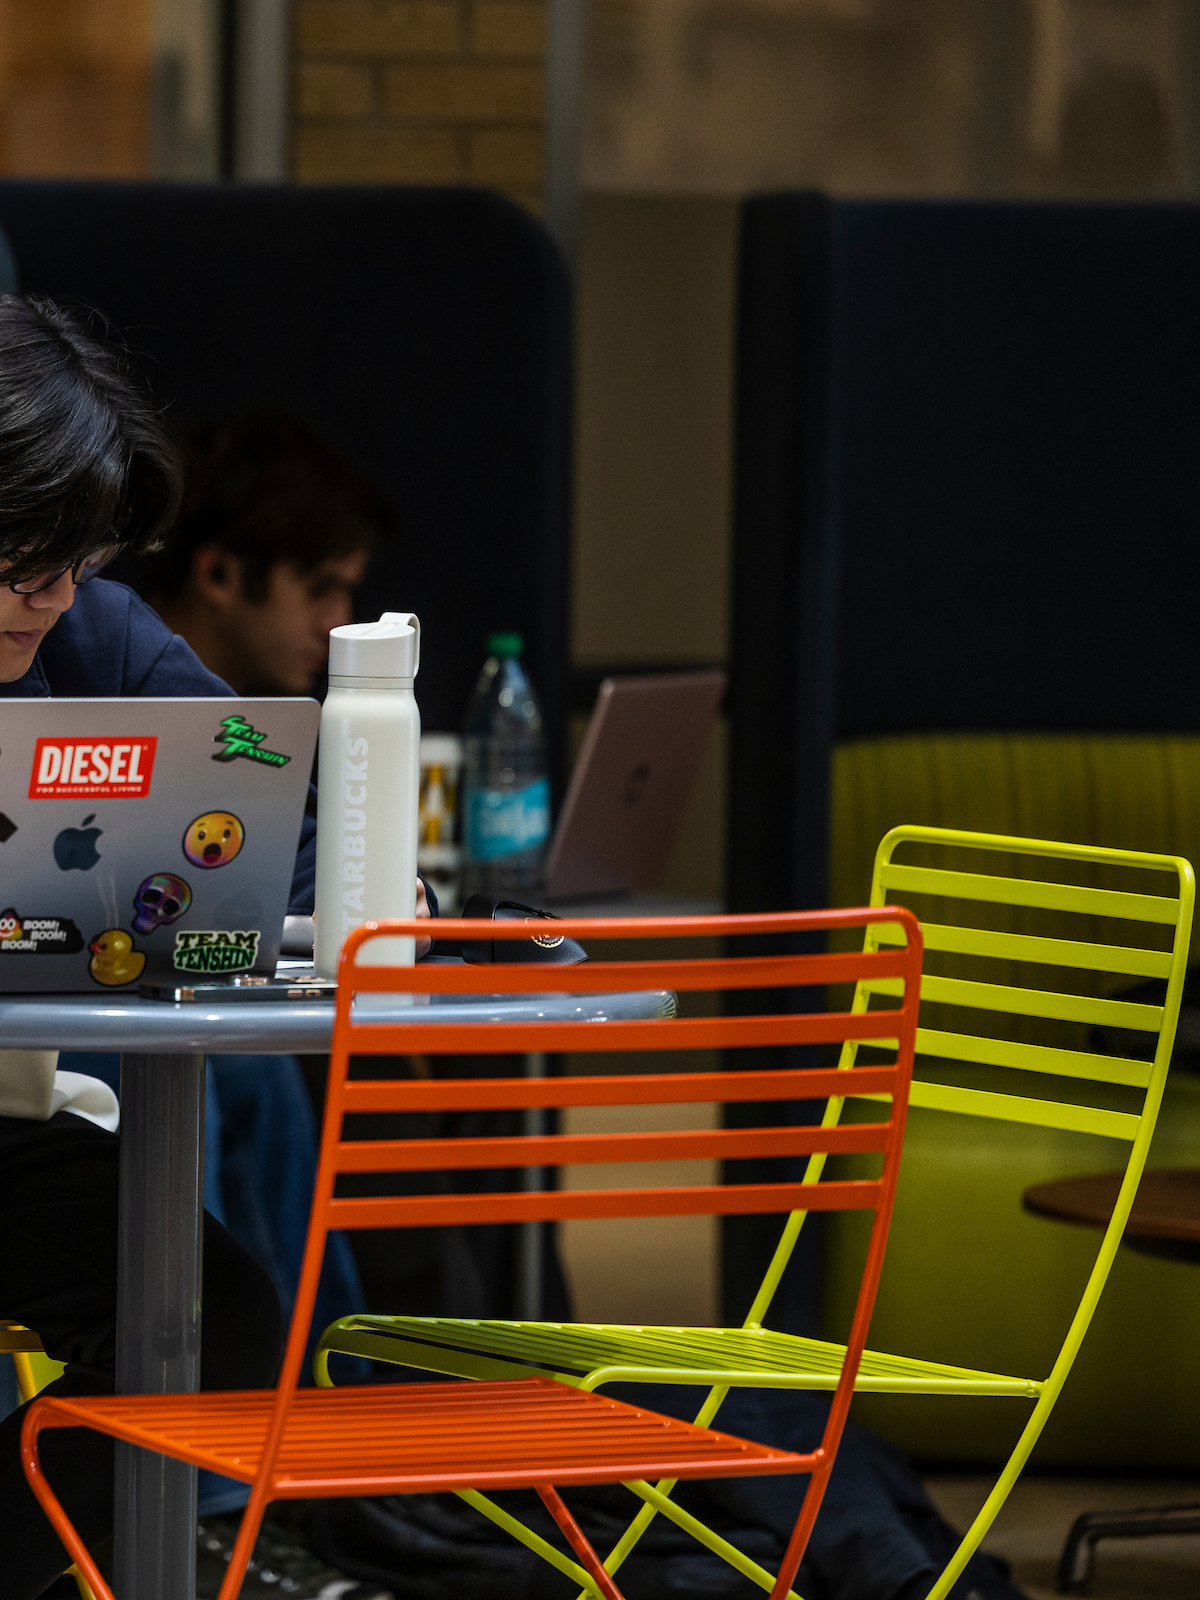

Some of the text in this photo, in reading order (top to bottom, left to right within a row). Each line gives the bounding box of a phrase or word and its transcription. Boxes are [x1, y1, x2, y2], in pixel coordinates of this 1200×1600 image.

[37, 744, 144, 784] DIESEL
[36, 785, 142, 794] FOR SUCCESSFUL LIVING
[341, 736, 369, 940] TARBUCKS
[23, 920, 60, 930] BOOM!
[30, 930, 67, 942] BOOM!
[179, 933, 258, 949] TEAM
[1, 940, 38, 951] BOOM!
[175, 947, 255, 971] TENSHIN
